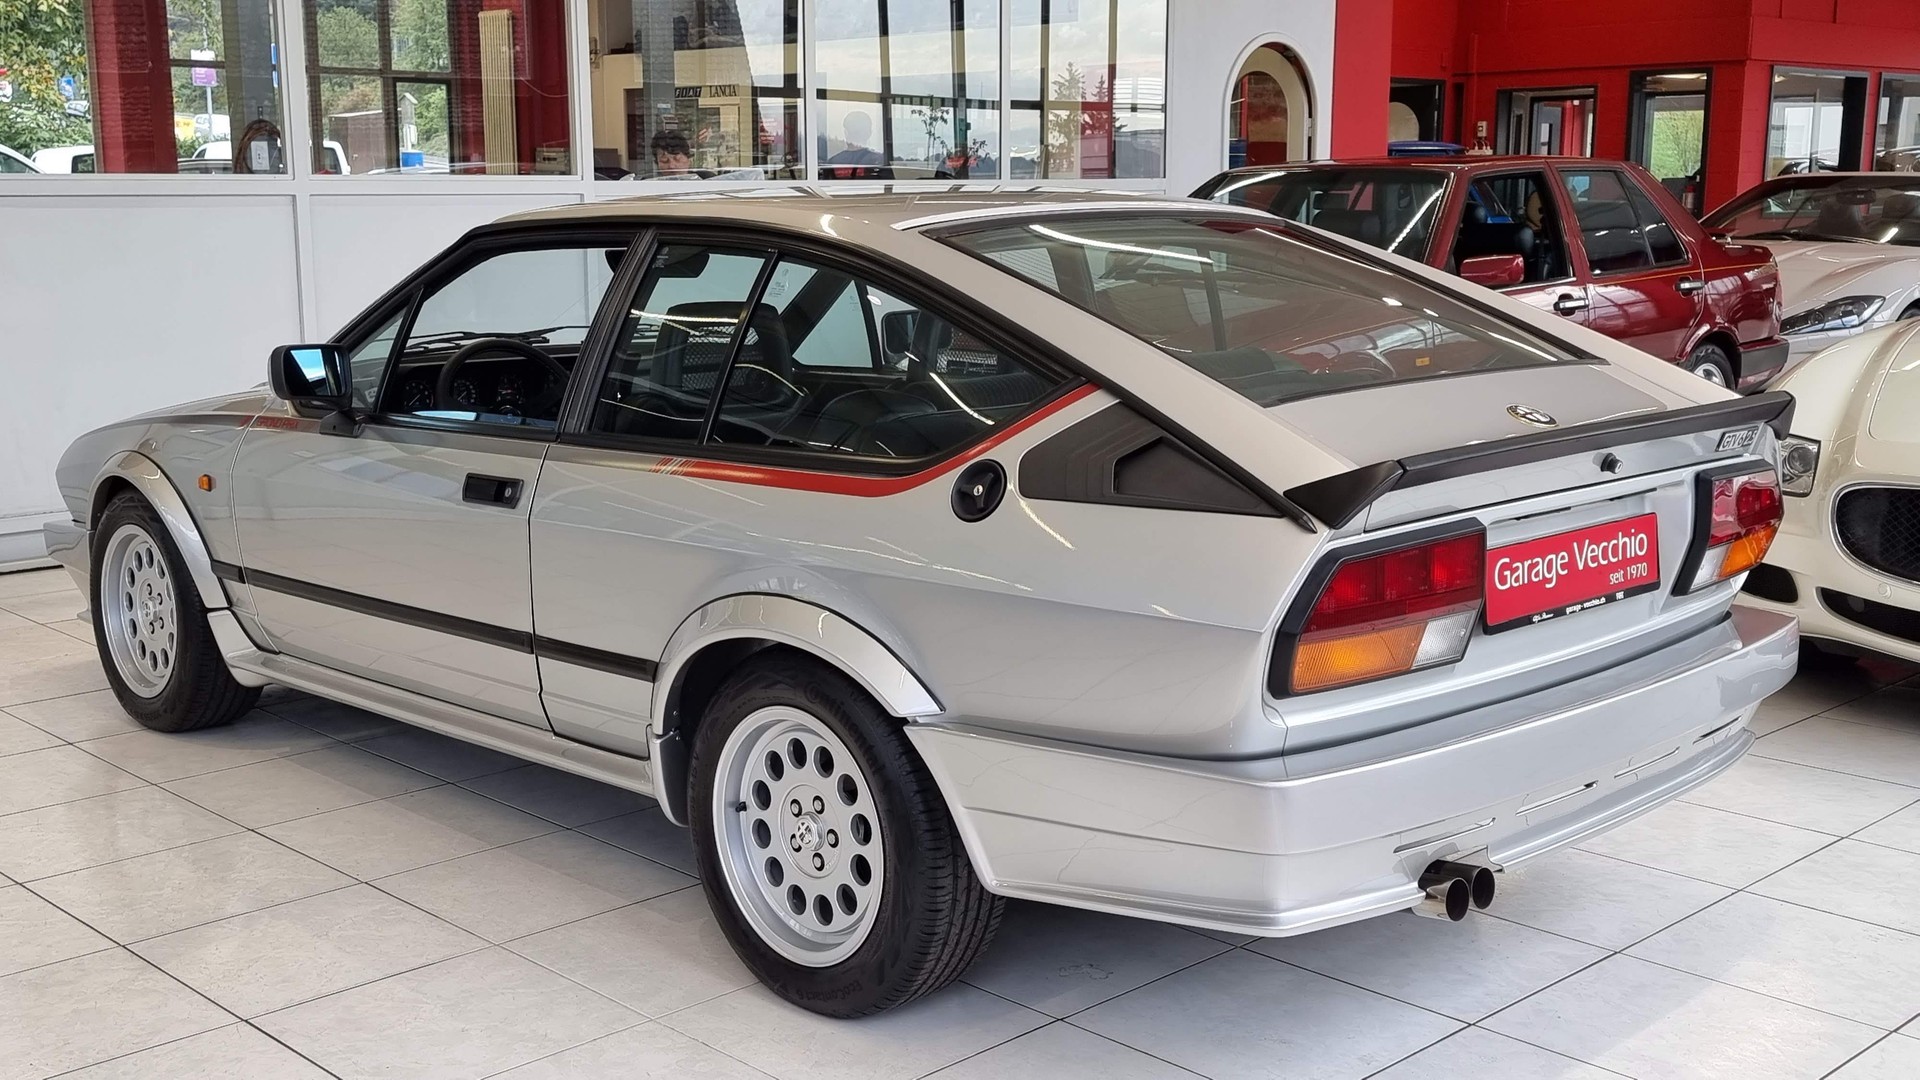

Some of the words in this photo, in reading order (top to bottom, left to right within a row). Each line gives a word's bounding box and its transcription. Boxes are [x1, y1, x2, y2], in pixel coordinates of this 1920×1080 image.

[675, 87, 702, 98] FIAT
[709, 85, 738, 97] LANCIA
[1494, 551, 1569, 590] Garage
[1573, 528, 1648, 571] Vecchio
[1609, 569, 1625, 585] seit
[1627, 562, 1648, 580] 1970
